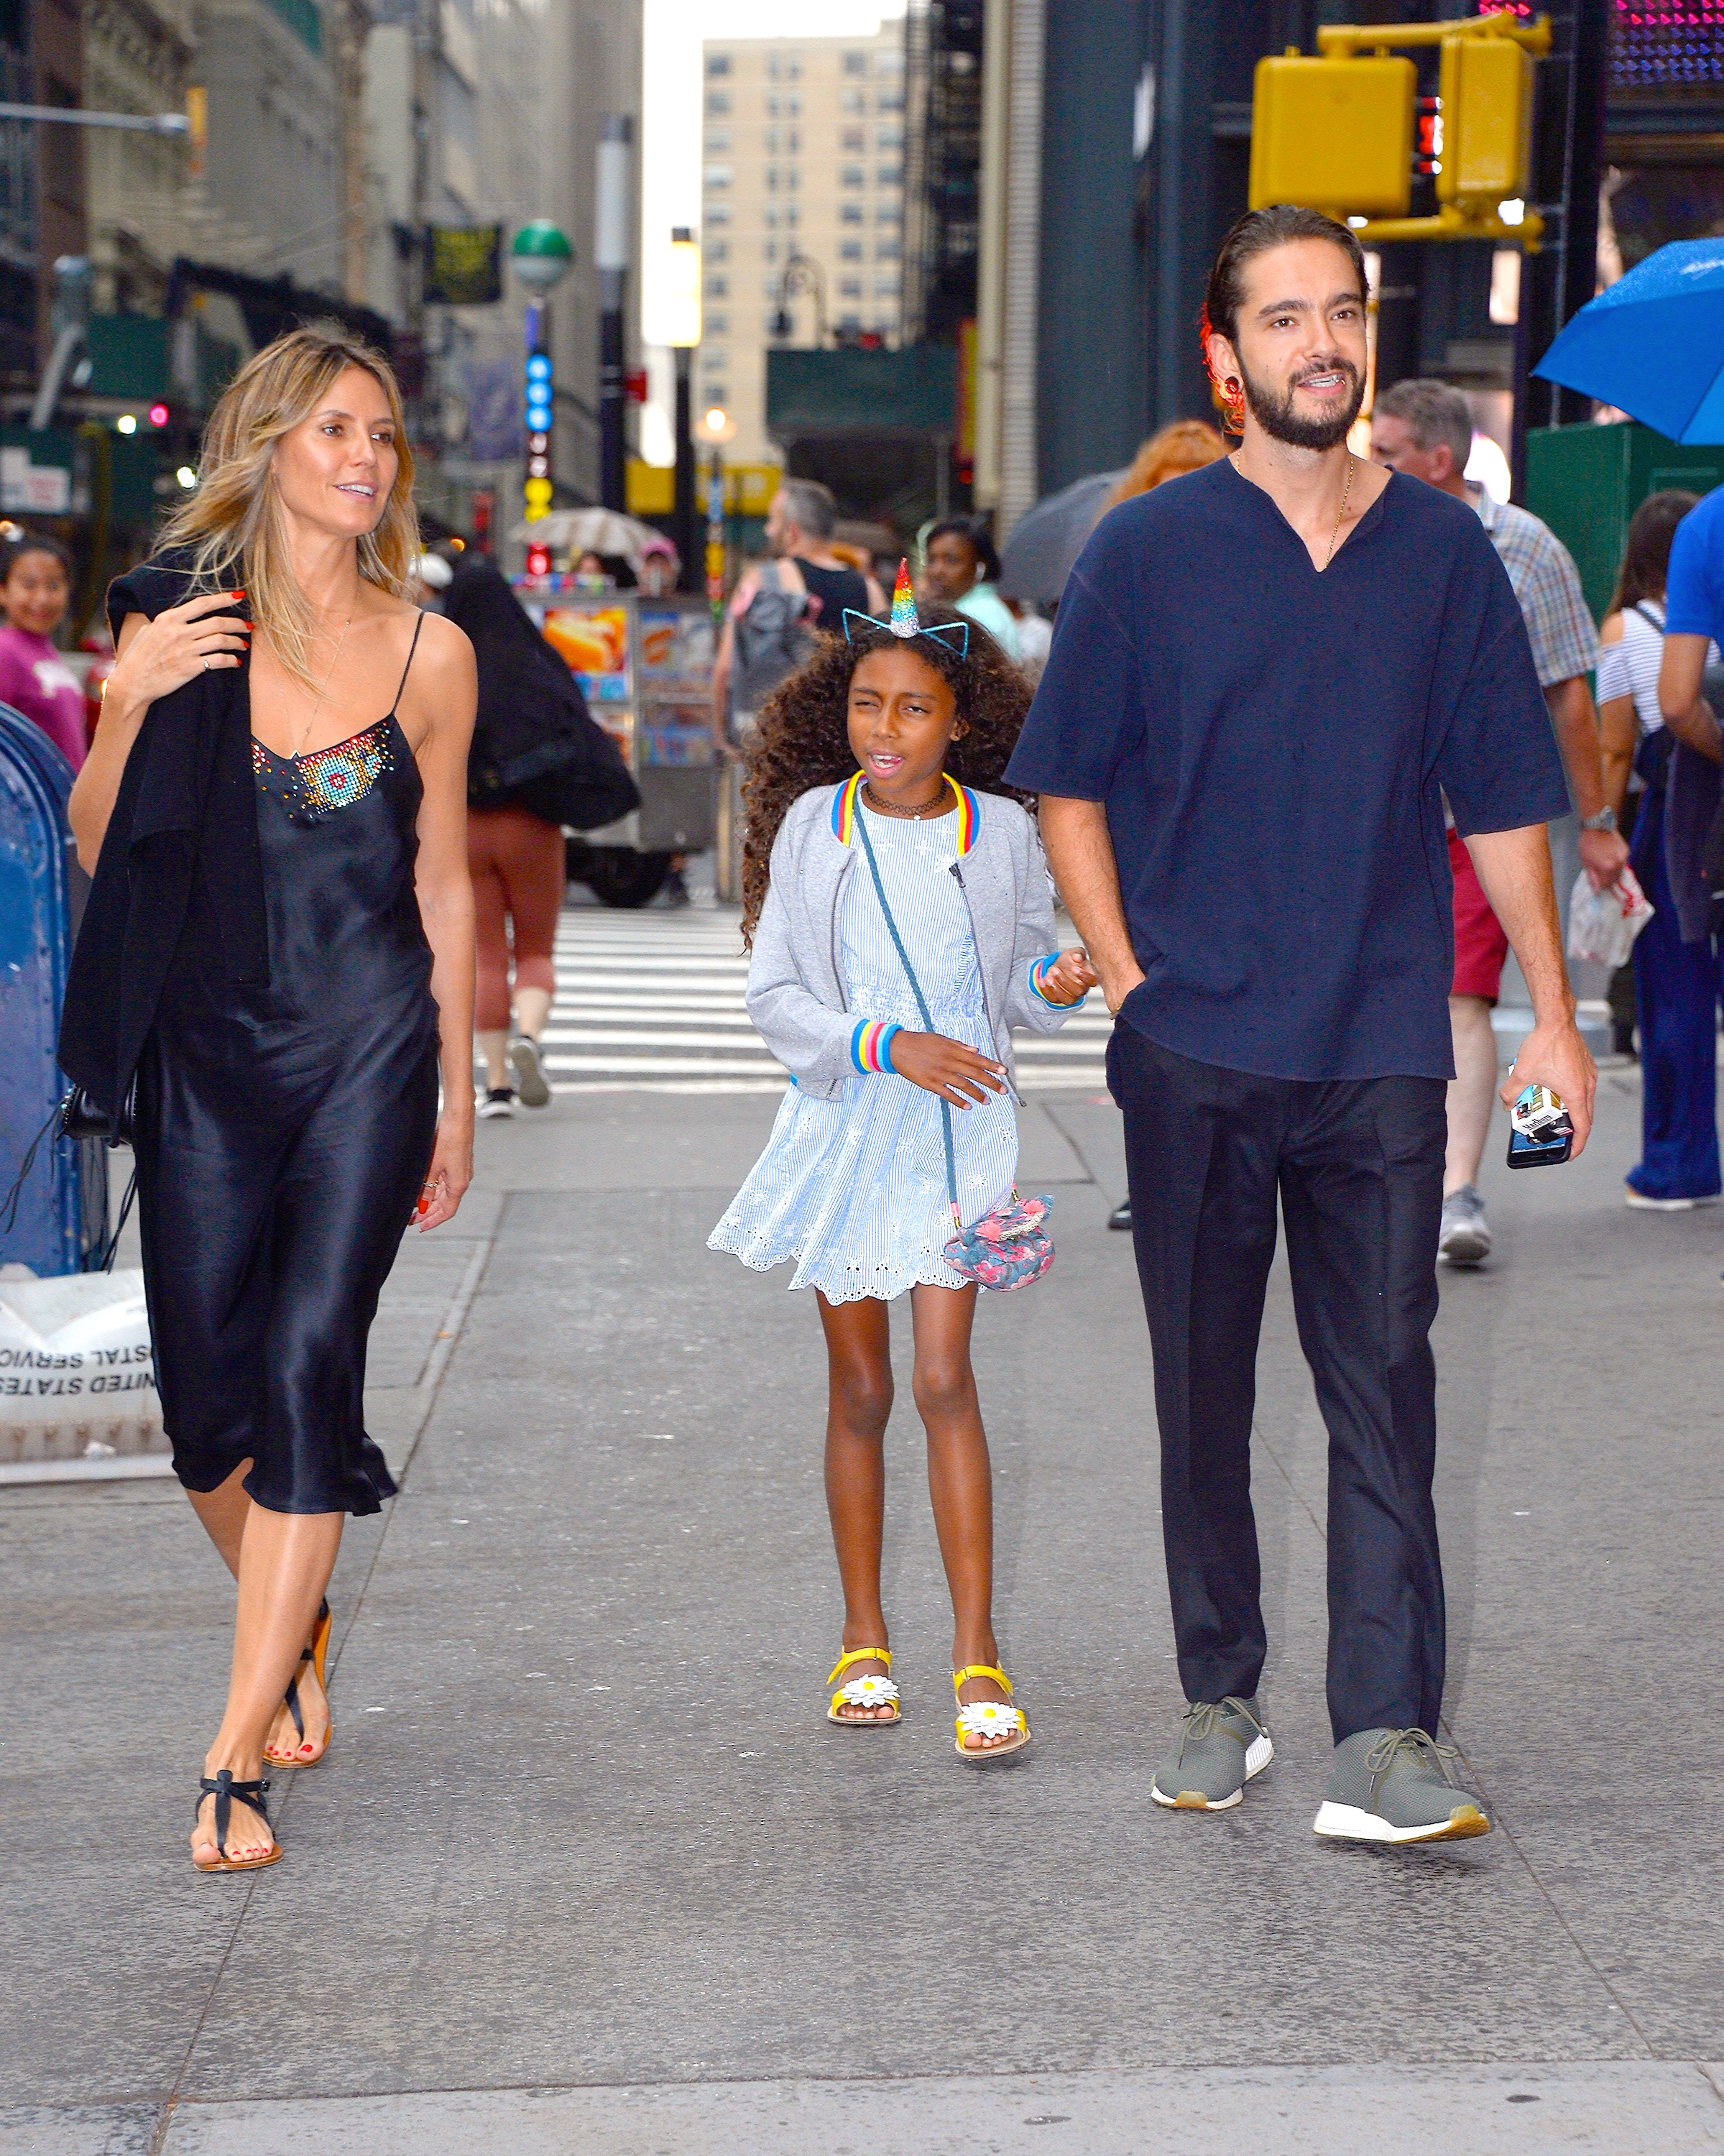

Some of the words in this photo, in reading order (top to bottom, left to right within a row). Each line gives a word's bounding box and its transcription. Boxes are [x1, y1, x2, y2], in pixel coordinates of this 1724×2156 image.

[0, 1349, 85, 1370] SERVIC
[90, 1345, 152, 1367] STAL
[90, 1373, 155, 1394] NITED
